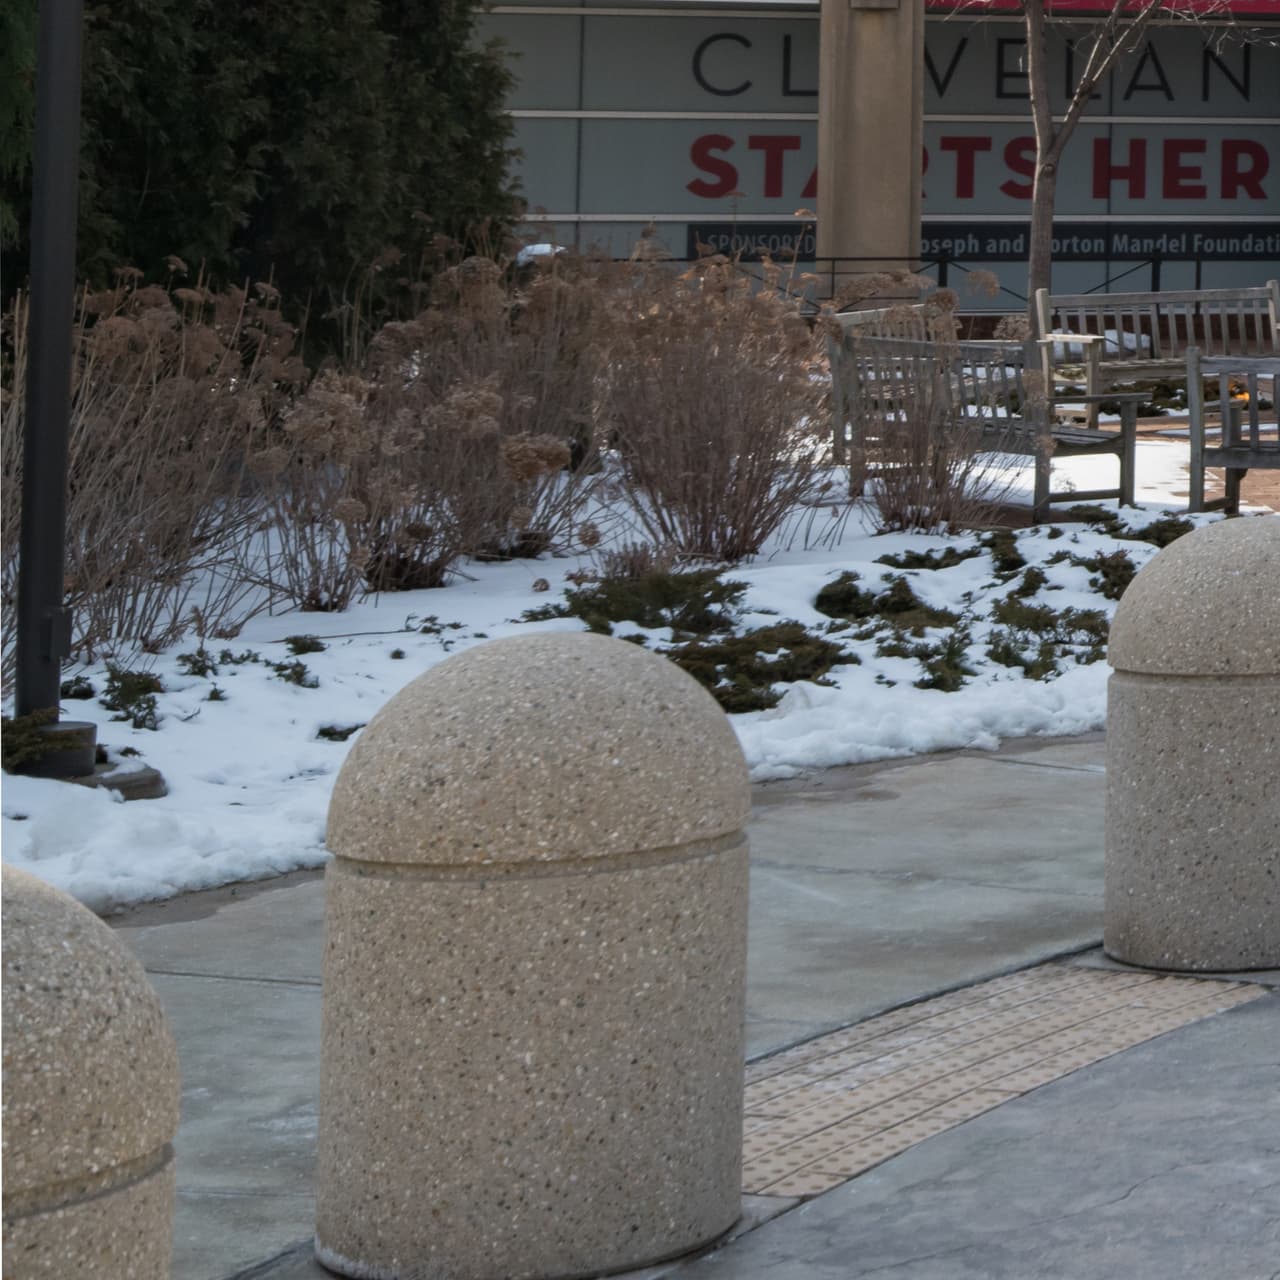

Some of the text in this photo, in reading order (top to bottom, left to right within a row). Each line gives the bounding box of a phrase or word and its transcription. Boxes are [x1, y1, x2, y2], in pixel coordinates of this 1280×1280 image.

[686, 133, 1038, 200] STTS
[920, 233, 978, 257] oseph
[985, 233, 1025, 254] and
[1050, 235, 1105, 254] orton
[1112, 234, 1187, 254] Mandel
